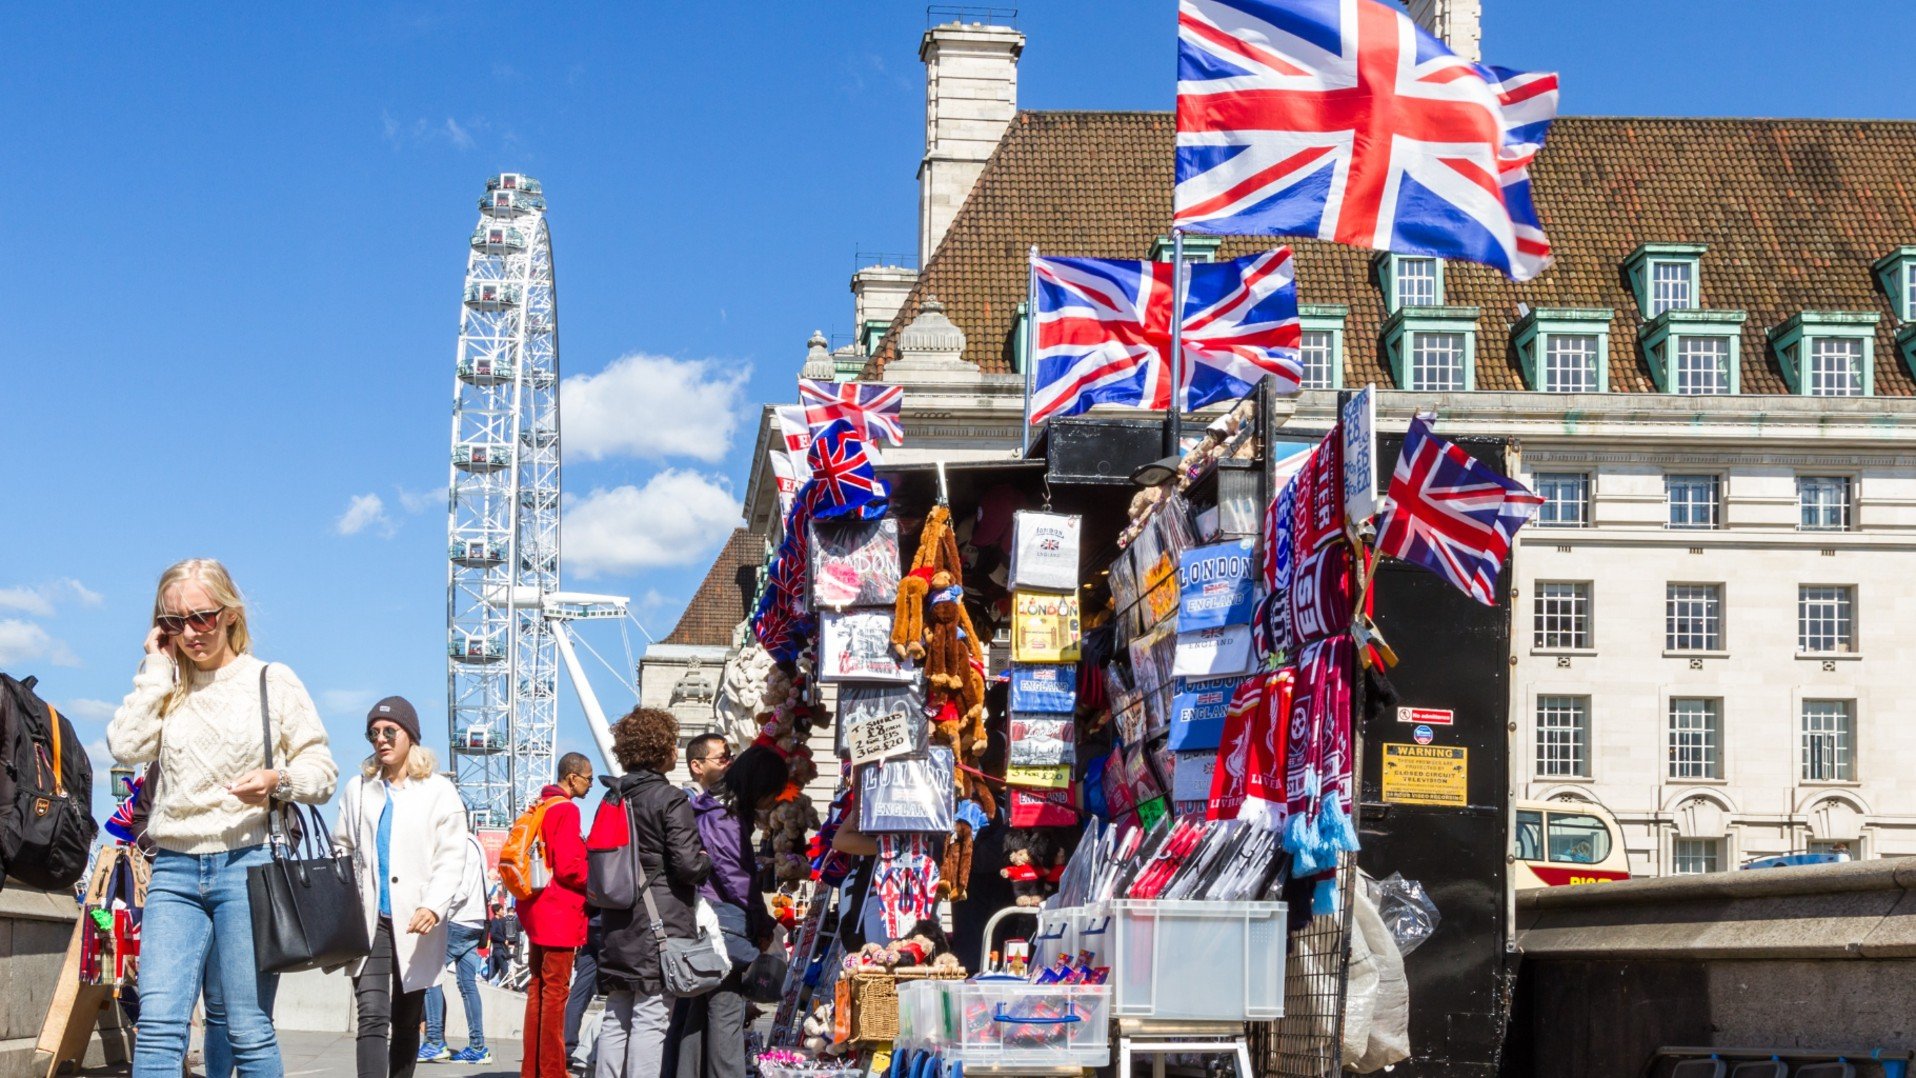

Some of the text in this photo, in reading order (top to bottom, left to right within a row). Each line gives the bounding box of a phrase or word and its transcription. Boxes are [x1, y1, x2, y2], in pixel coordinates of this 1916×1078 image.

[1180, 556, 1254, 589] LONDON
[1187, 594, 1244, 612] ENGLAND
[1189, 639, 1234, 649] ENGLAND
[1021, 680, 1068, 693] ENGLAND
[1181, 704, 1230, 722] ENGLAN
[855, 741, 863, 750] 2
[883, 730, 899, 741] £15
[867, 725, 885, 739] £8
[857, 749, 865, 758] 3
[883, 737, 904, 751] £20
[1397, 747, 1454, 757] WARNING
[865, 760, 950, 795] LONON
[1041, 772, 1063, 780] £20
[876, 802, 928, 818] ENGLAN
